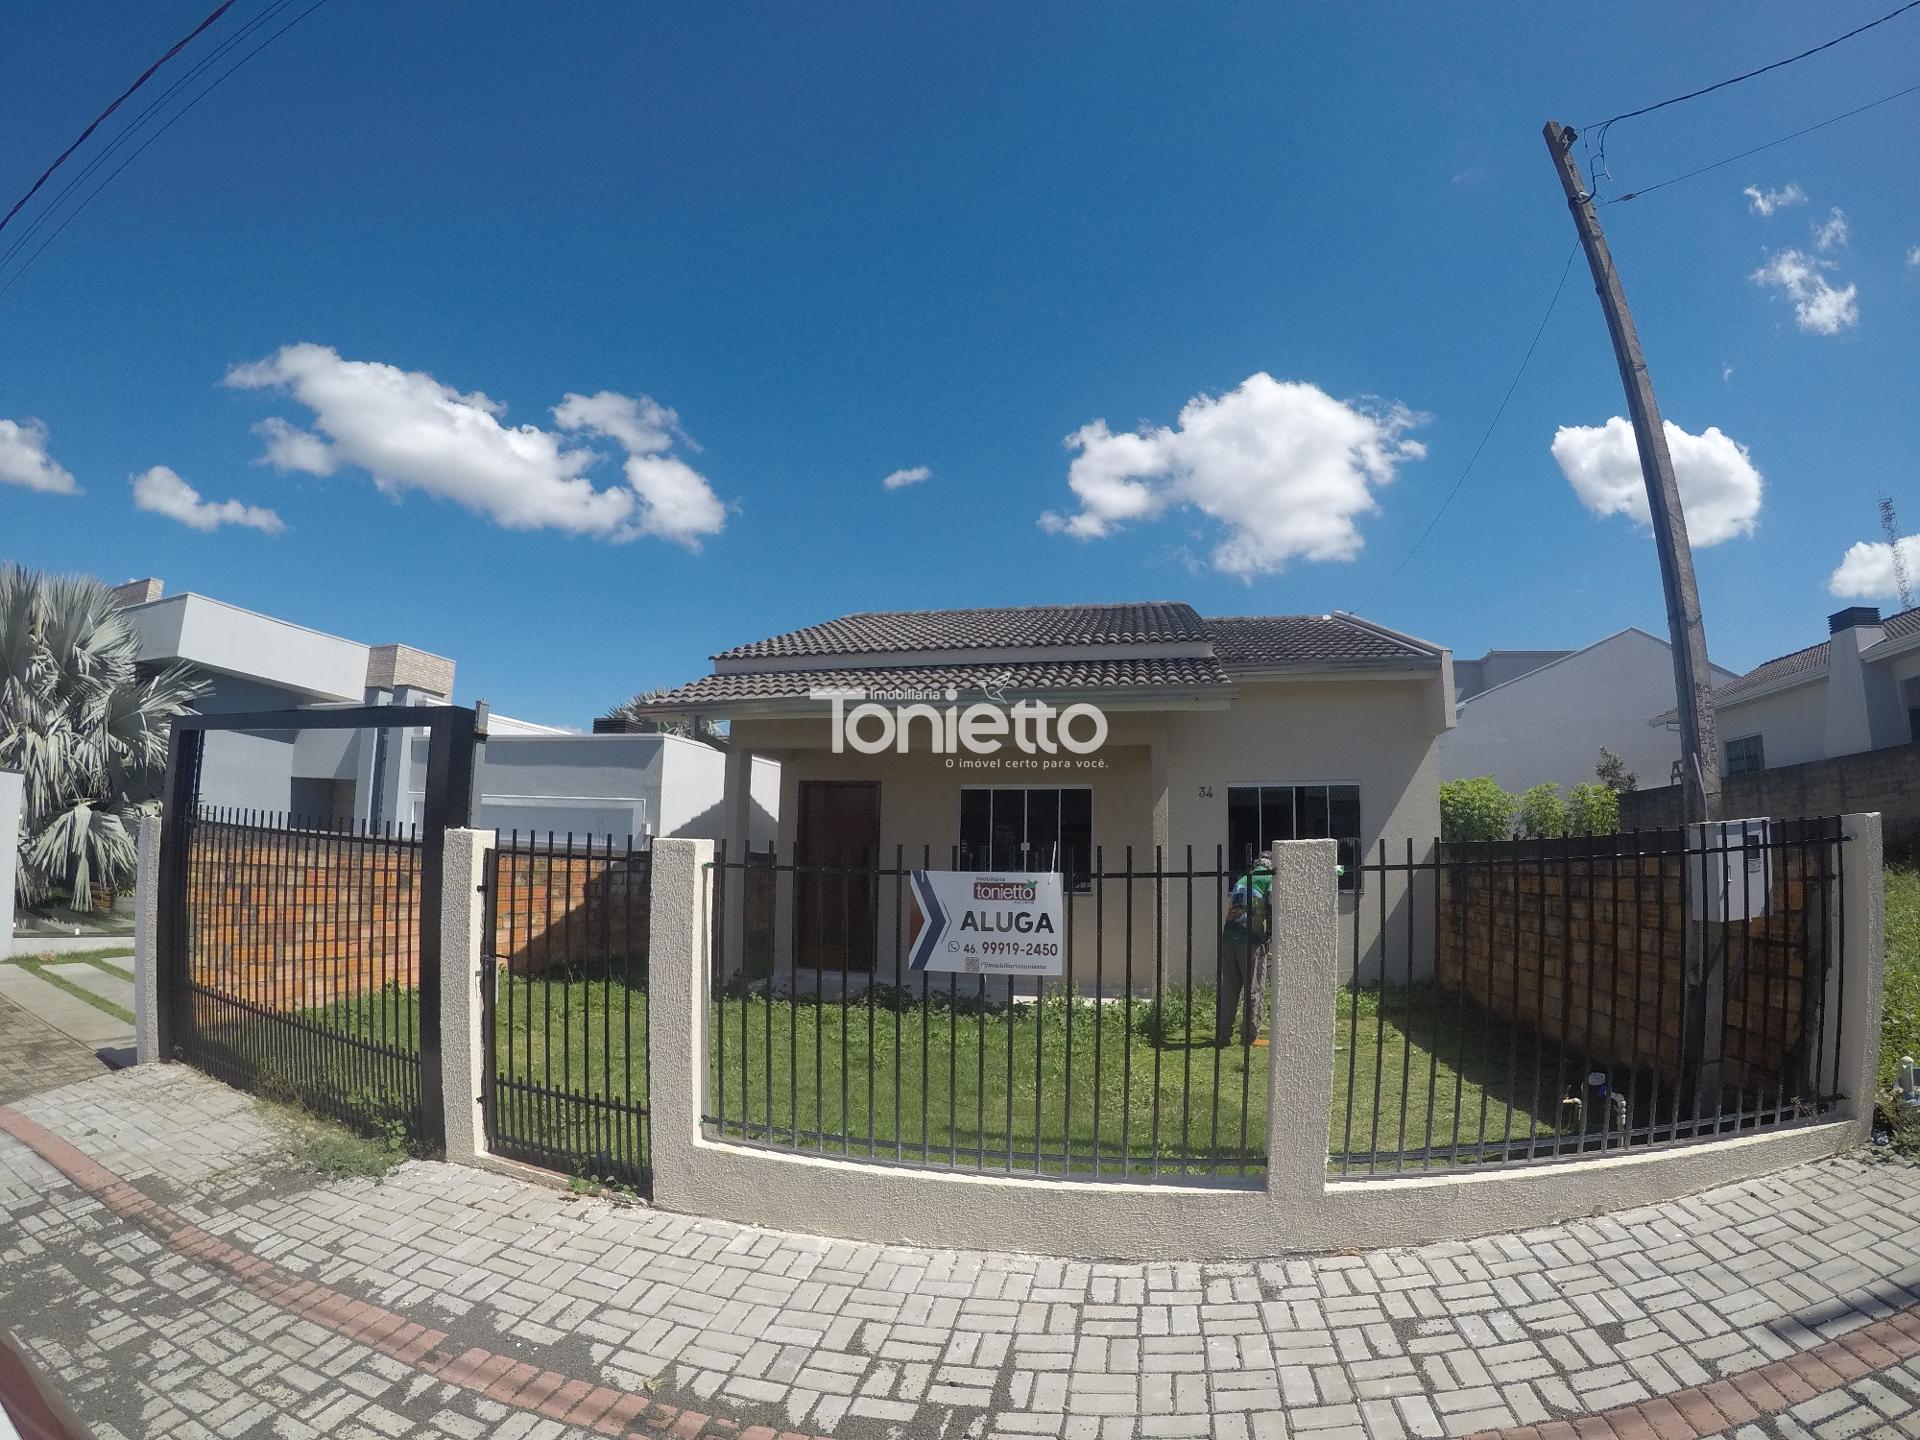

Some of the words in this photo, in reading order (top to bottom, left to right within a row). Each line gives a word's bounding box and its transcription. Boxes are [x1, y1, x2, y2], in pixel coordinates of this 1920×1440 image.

[1199, 786, 1214, 799] 34
[975, 884, 1034, 900] tonietto
[960, 911, 1054, 933] ALUGA
[982, 942, 1058, 957] 99919-2450
